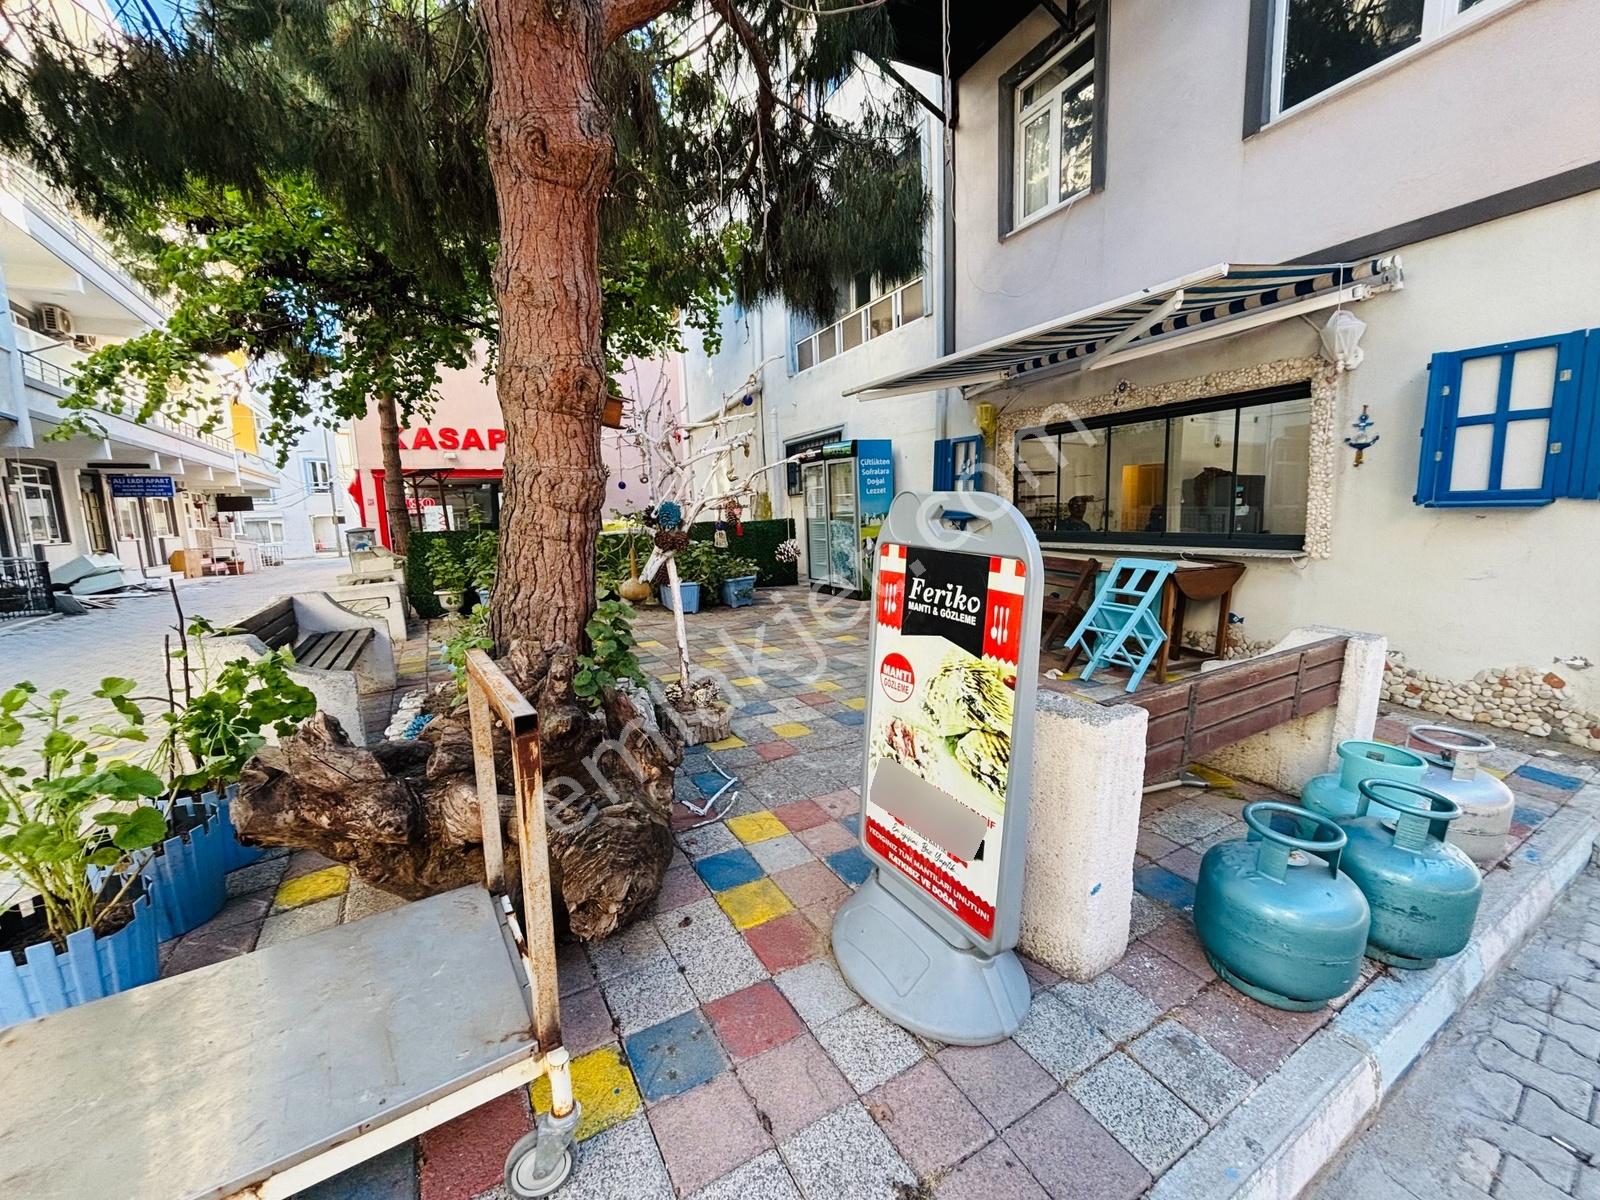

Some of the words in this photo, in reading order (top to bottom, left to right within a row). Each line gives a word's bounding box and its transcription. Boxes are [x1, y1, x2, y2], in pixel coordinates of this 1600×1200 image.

[860, 459, 890, 468] Çiftlikten
[861, 468, 890, 476] Sofralara
[866, 478, 886, 486] Doğal
[909, 577, 981, 614] Feriko
[908, 601, 932, 616] MANTI
[933, 609, 939, 617] &
[940, 608, 977, 626] GÖZLEME
[883, 663, 913, 683] MANTI
[920, 875, 932, 890] VE
[931, 884, 959, 911] DOĞAL
